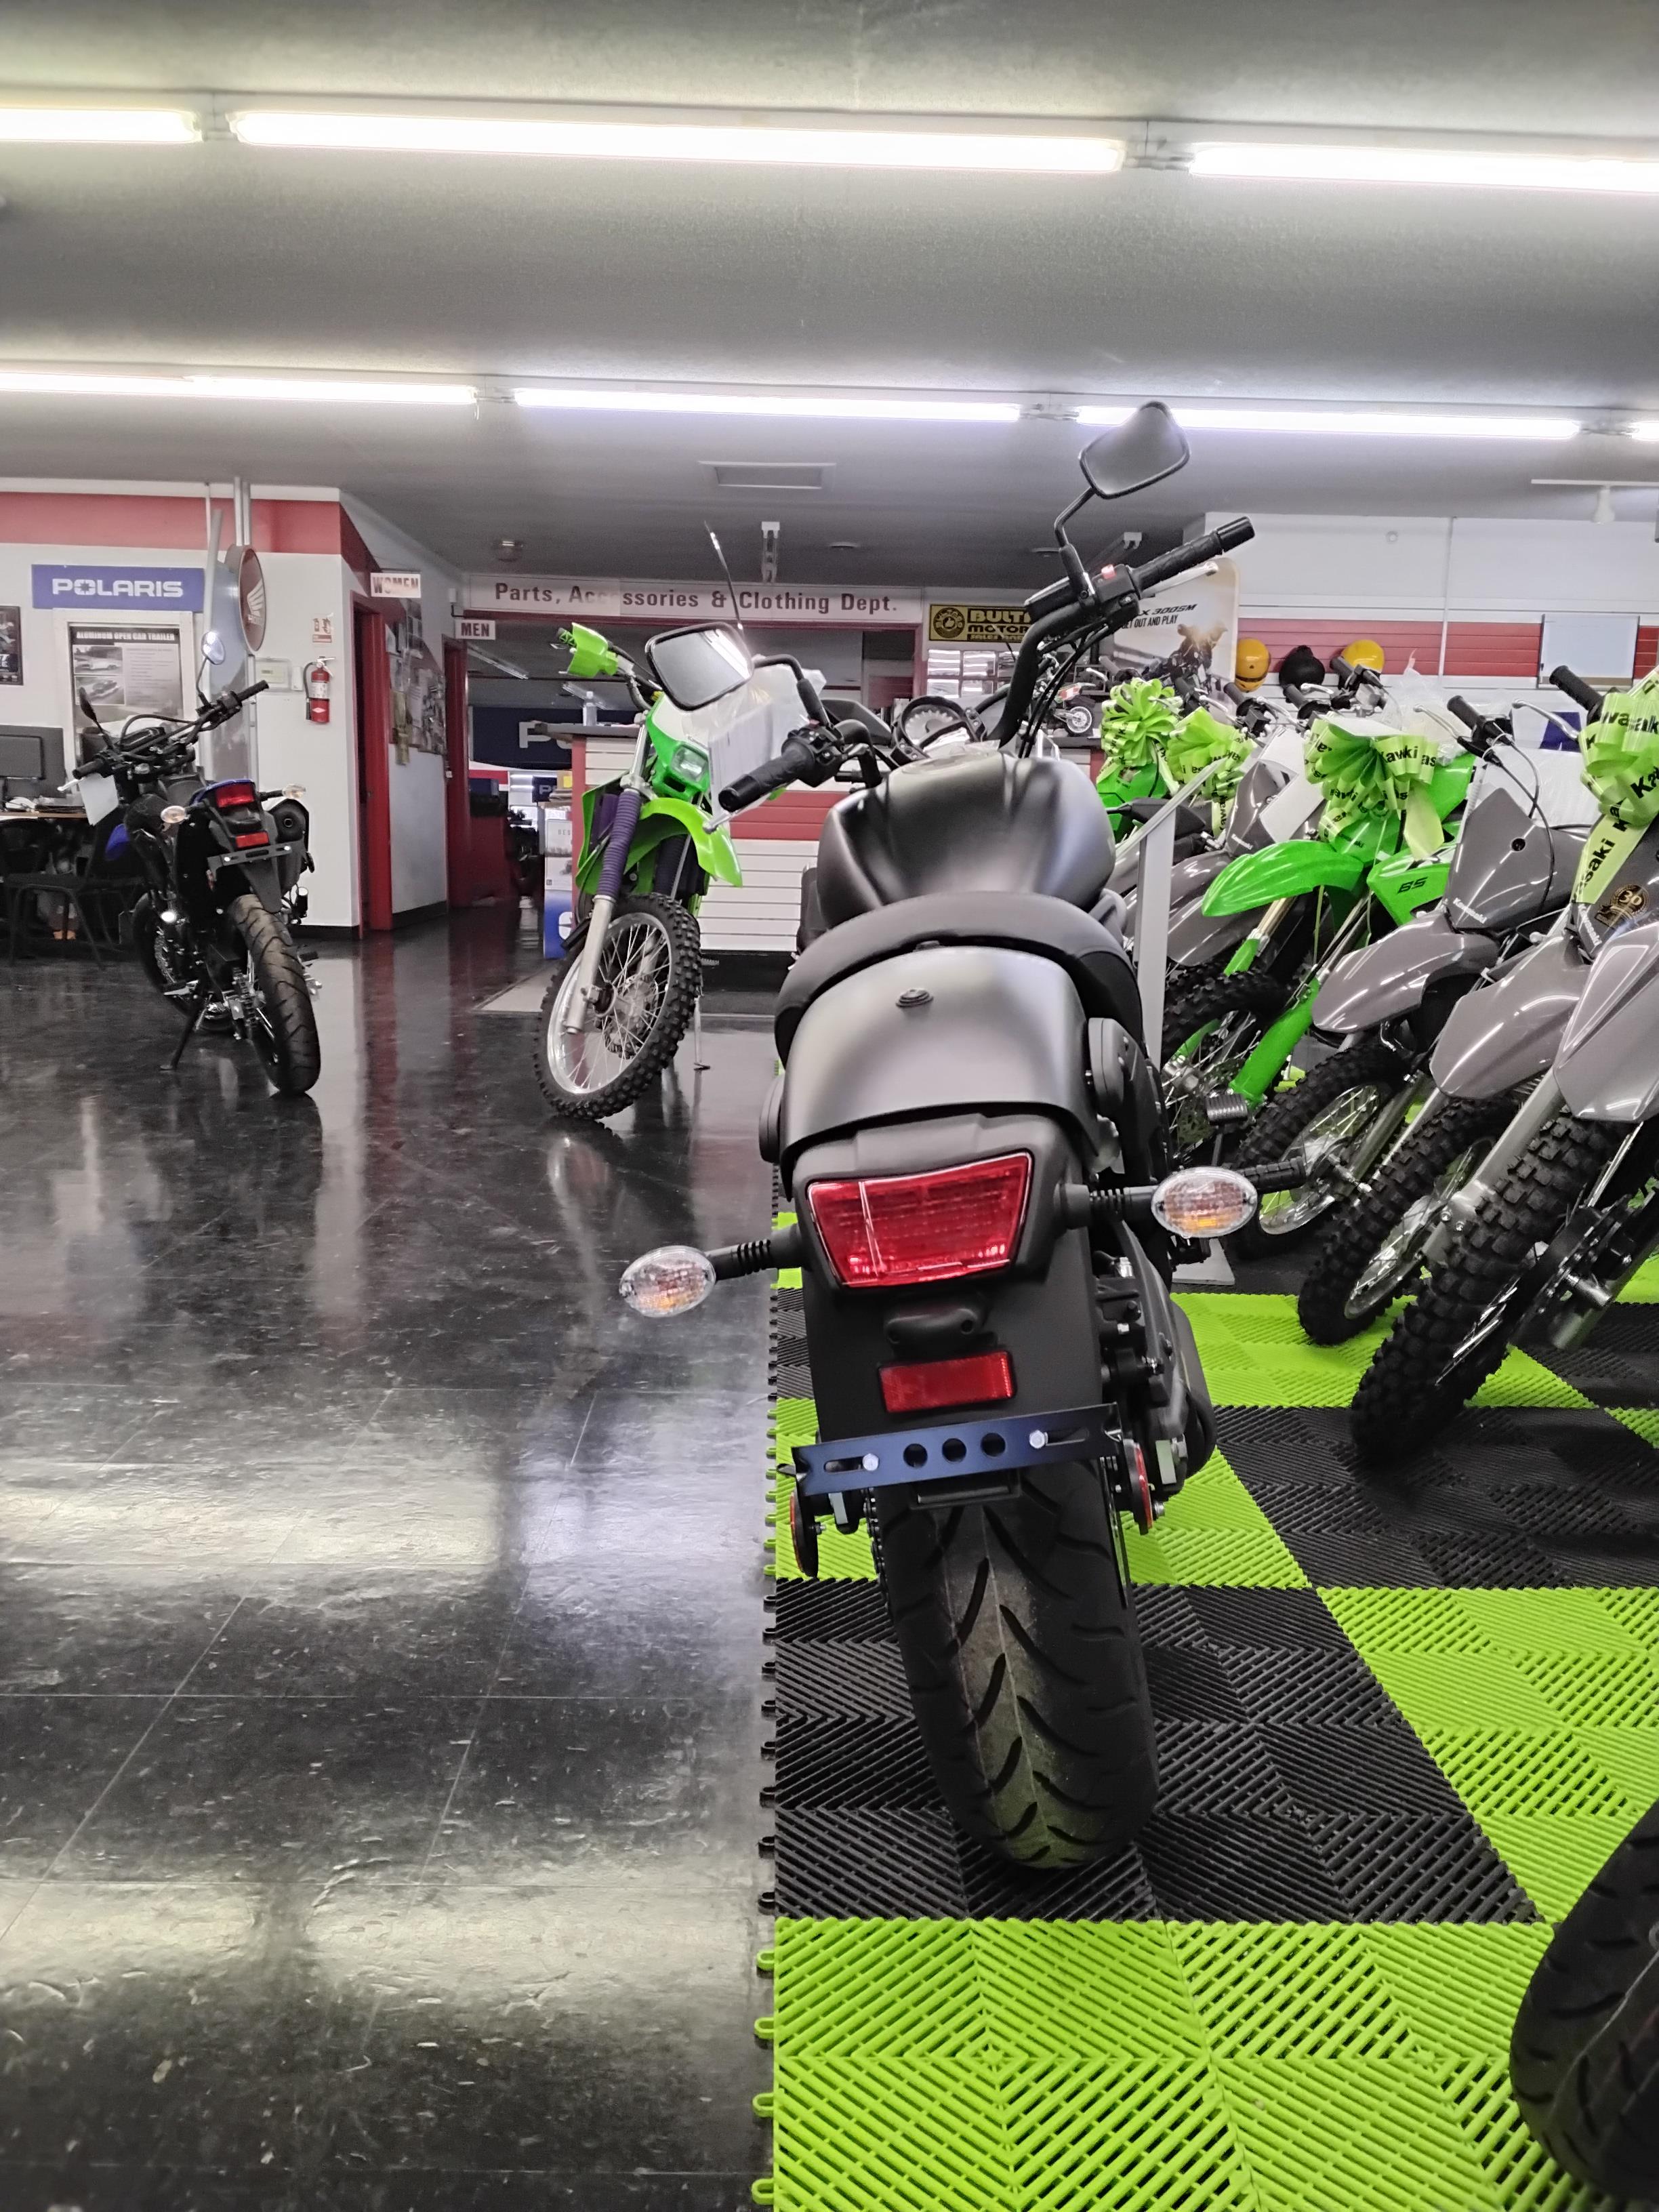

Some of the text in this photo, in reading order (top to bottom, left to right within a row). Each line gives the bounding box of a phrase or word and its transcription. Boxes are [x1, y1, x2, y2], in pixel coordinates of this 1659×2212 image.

[52, 578, 184, 598] POLARIS
[495, 582, 897, 615] Parts, Accssories & Clothing Dept.
[1134, 617, 1147, 628] OUT
[1147, 616, 1161, 627] AND
[1161, 614, 1179, 625] PLAY
[461, 622, 490, 637] MEN
[1619, 890, 1642, 905] 30
